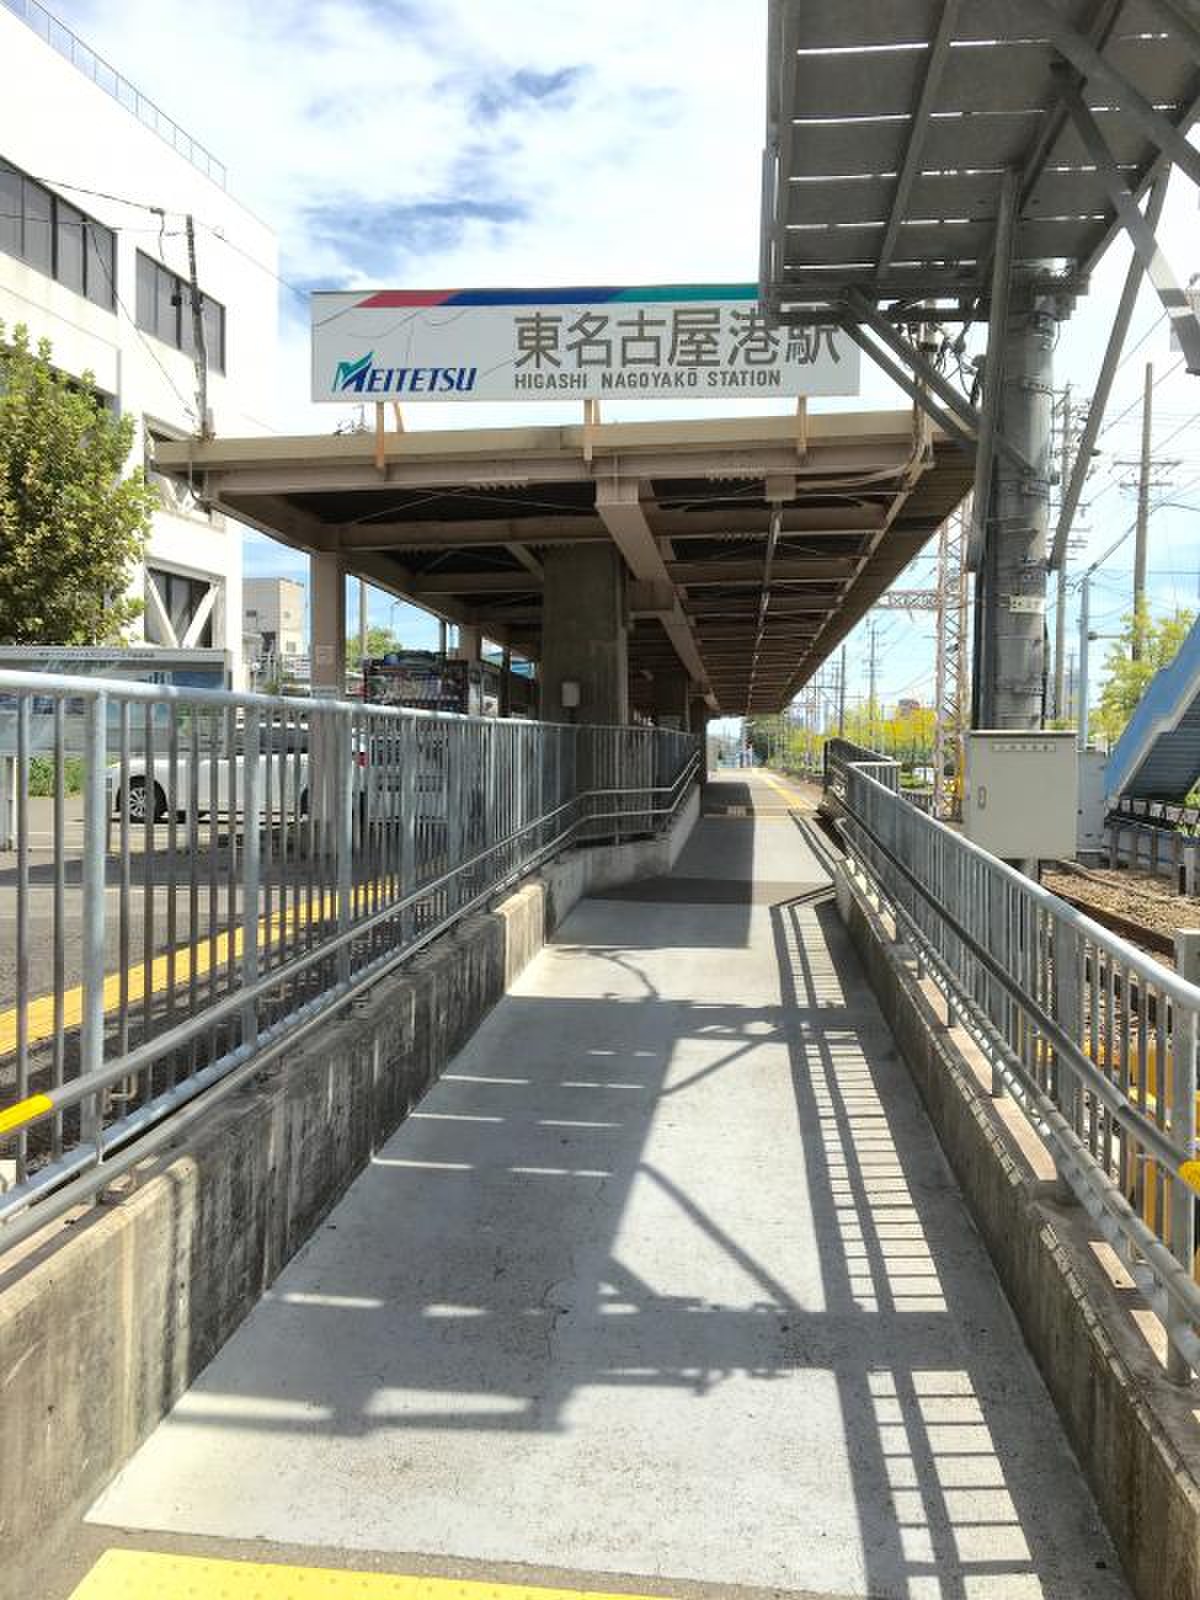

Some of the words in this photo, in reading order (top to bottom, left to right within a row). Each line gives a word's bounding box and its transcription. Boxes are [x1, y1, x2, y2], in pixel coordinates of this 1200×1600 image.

[331, 350, 477, 392] MEITETSU
[514, 373, 587, 389] HIGASHI
[707, 370, 781, 387] STATION
